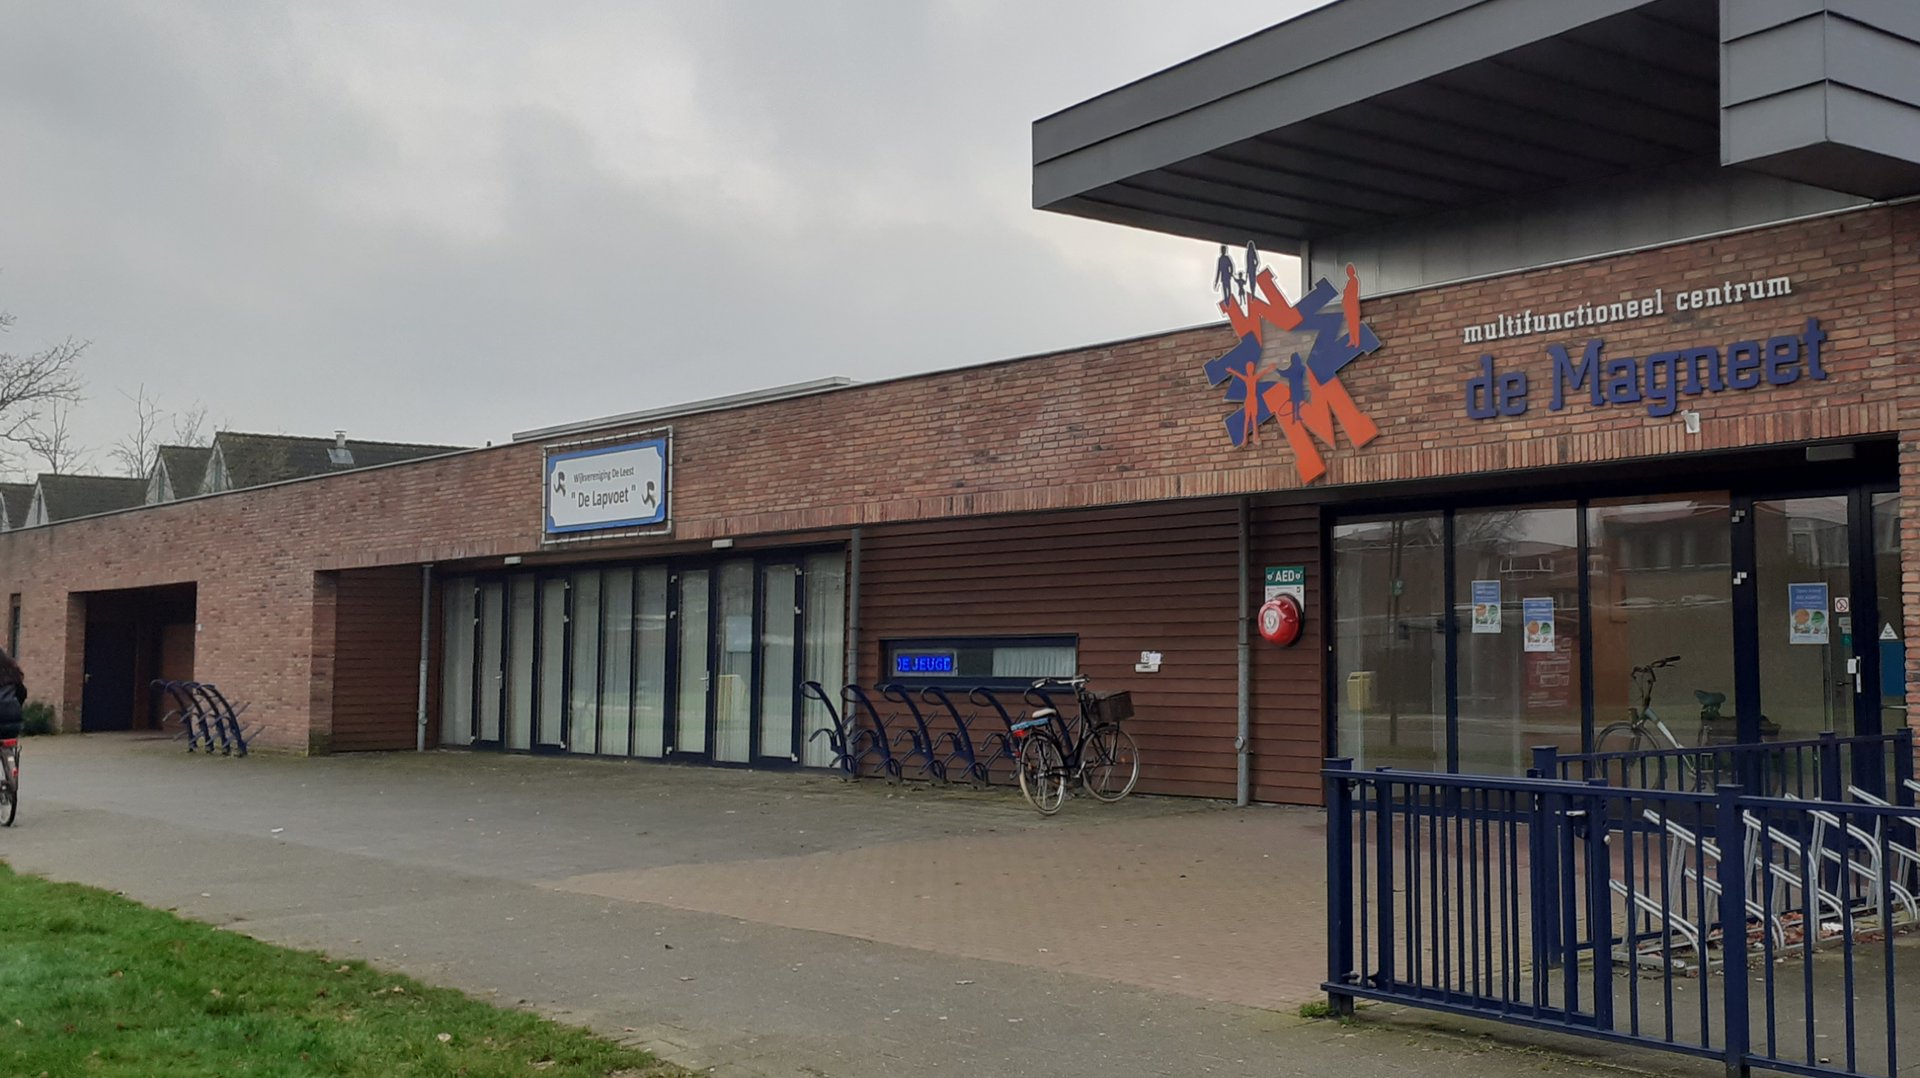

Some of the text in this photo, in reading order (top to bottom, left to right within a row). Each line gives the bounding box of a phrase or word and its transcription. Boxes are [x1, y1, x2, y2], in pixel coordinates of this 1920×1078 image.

[1463, 276, 1792, 343] multifunctioneel centrum
[1466, 317, 1827, 420] de Magneet
[574, 466, 634, 484] Wijkvereniging De Leest
[592, 487, 629, 510] Lapvoet
[1275, 569, 1295, 582] AED
